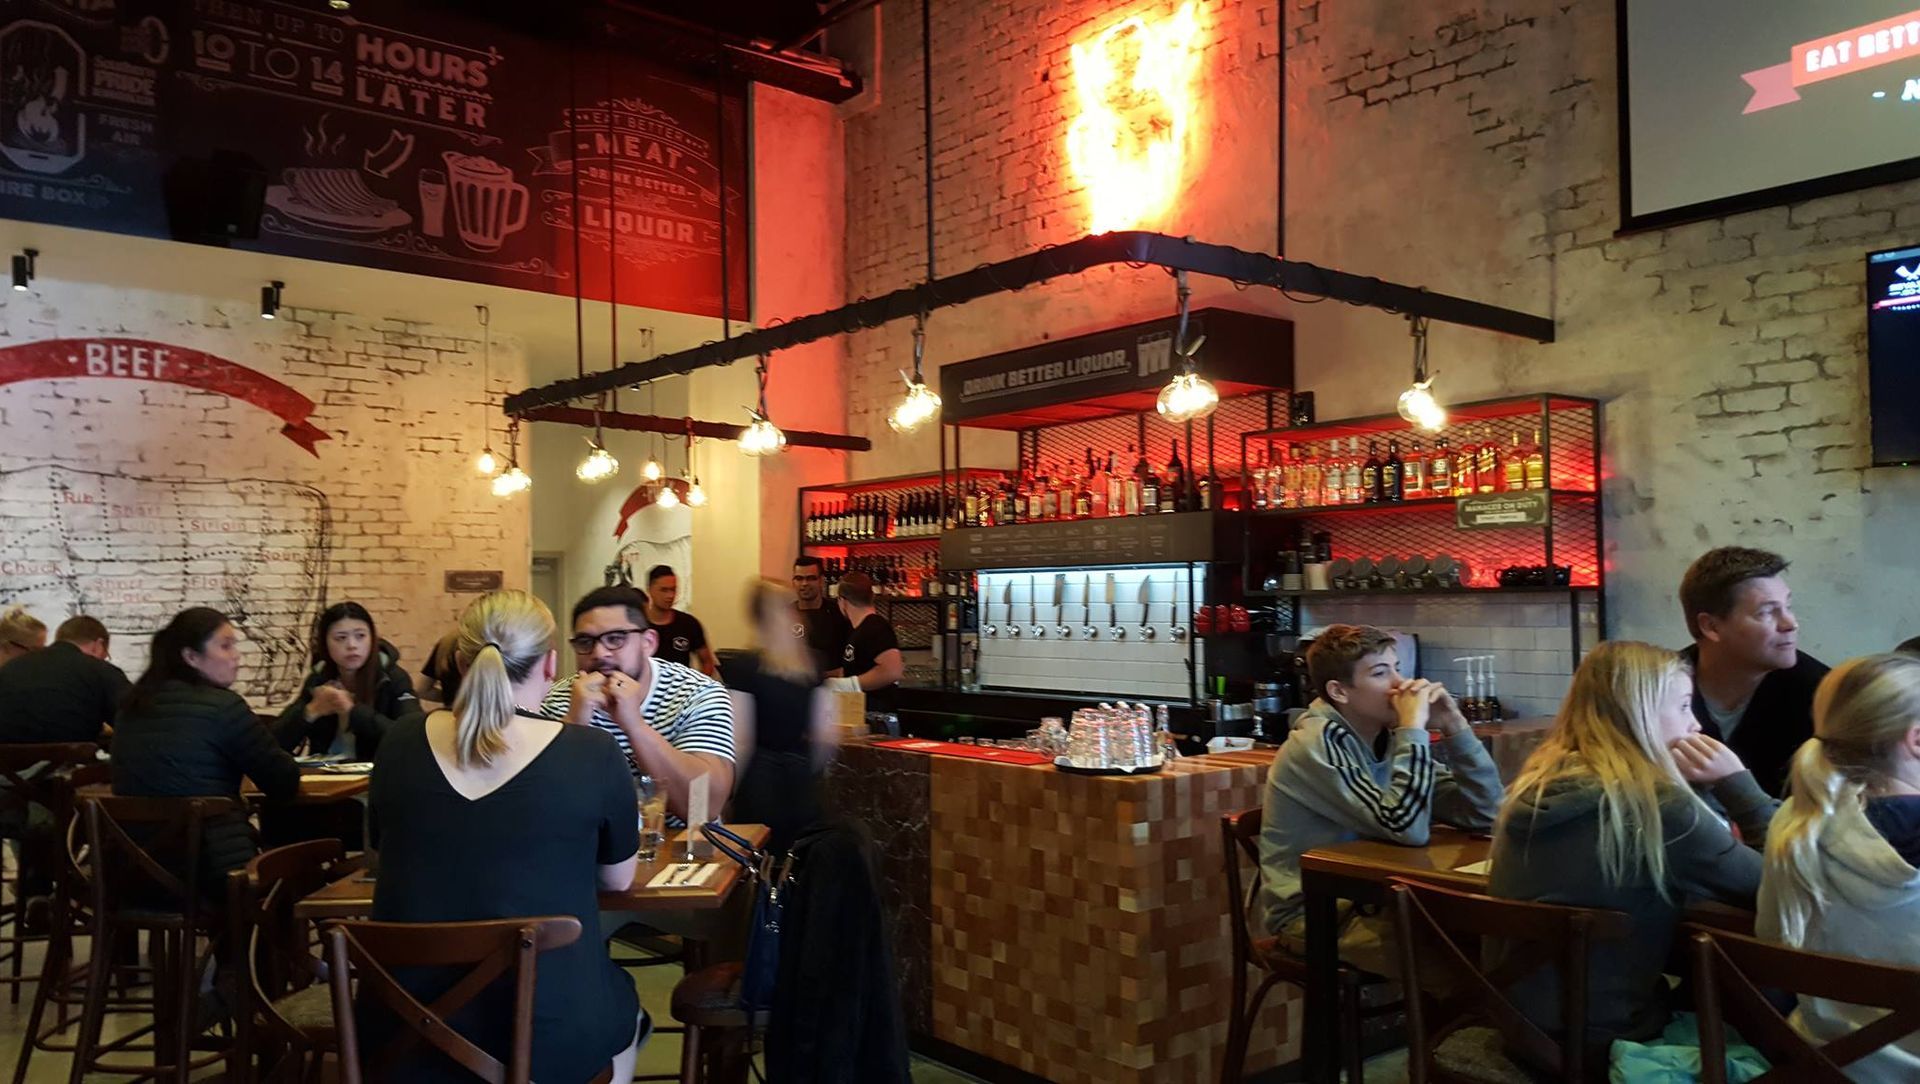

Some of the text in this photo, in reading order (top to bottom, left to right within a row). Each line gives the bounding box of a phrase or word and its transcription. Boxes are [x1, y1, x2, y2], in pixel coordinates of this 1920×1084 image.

[274, 13, 305, 33] UP
[314, 23, 344, 44] TO
[192, 29, 345, 84] 10 TO 14
[357, 33, 489, 88] HOURS
[1806, 40, 1851, 72] EAT
[356, 76, 487, 128] LATER
[592, 111, 684, 142] EAT BETTER
[594, 132, 683, 169] MEAT
[41, 186, 87, 206] BOX
[634, 175, 686, 197] BETTER
[584, 204, 695, 244] LIQUOR
[86, 343, 170, 379] BEEF
[963, 371, 1006, 396] DRINK
[1007, 361, 1064, 388] BETTER
[63, 490, 94, 505] Rib
